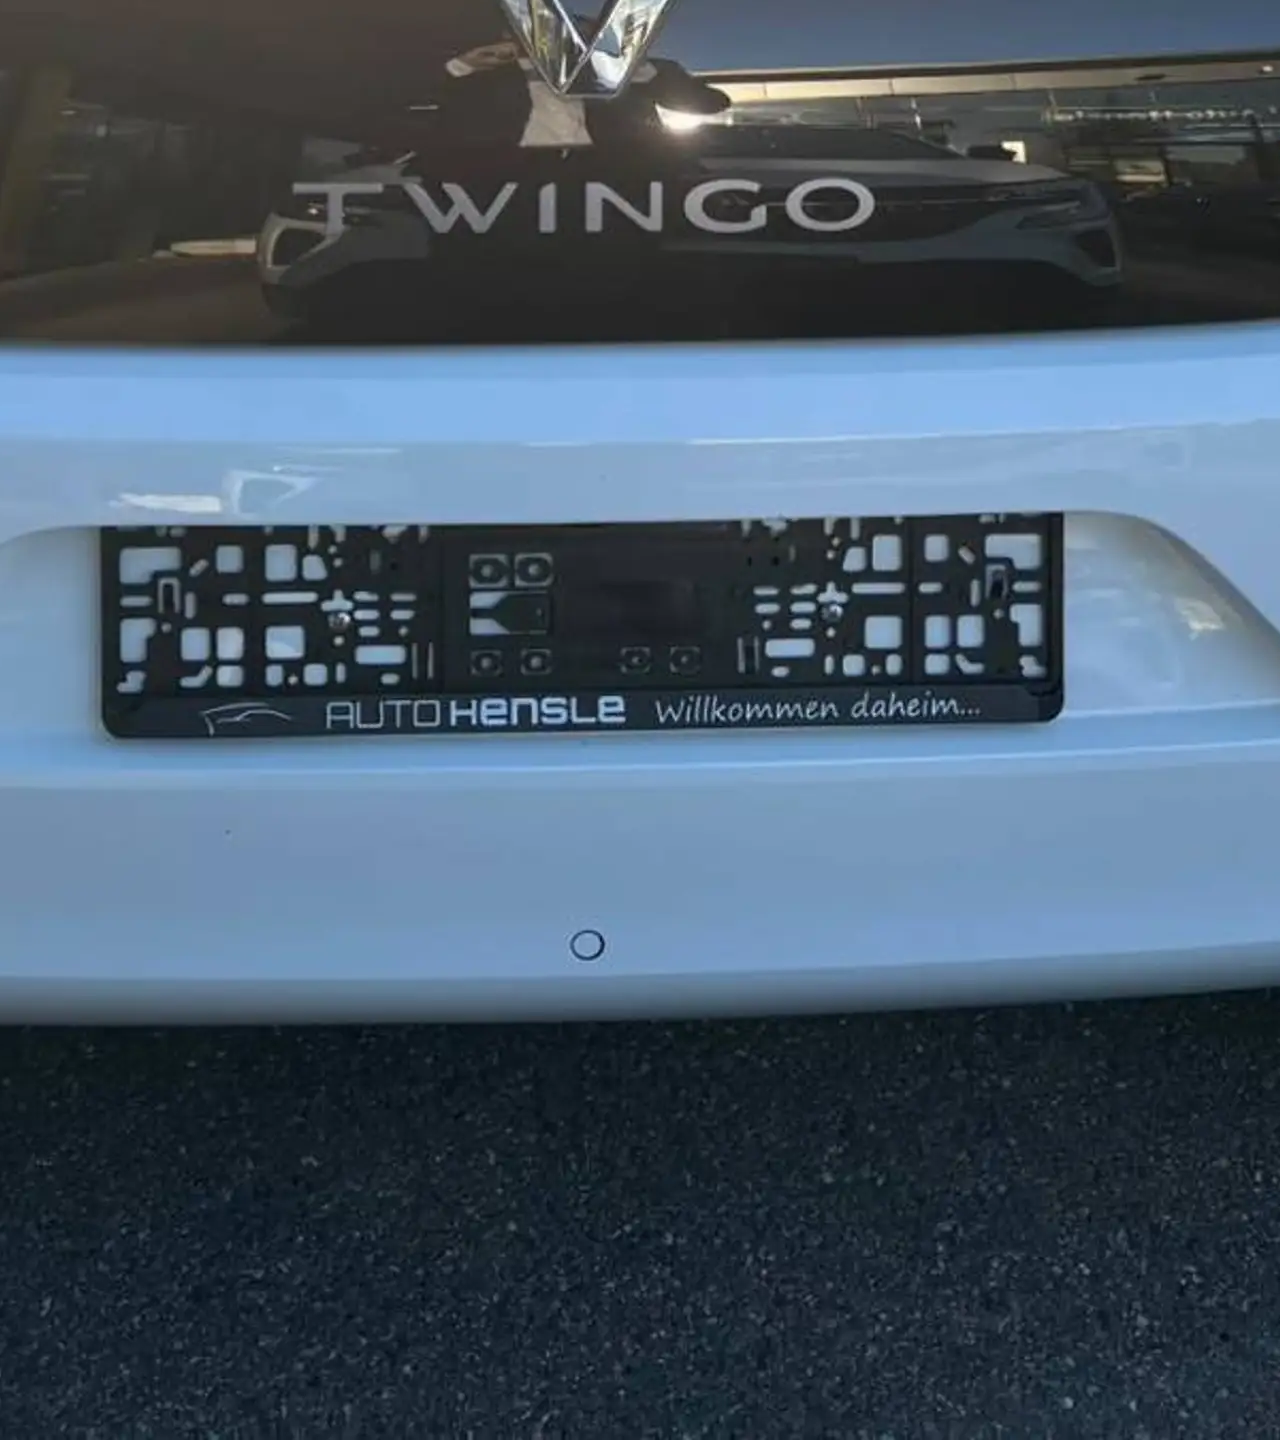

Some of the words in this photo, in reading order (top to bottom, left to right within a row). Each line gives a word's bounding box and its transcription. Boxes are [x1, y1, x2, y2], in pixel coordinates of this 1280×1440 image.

[291, 177, 877, 235] TWINGO
[326, 699, 441, 729] AUTO
[656, 694, 841, 724] Willkommen
